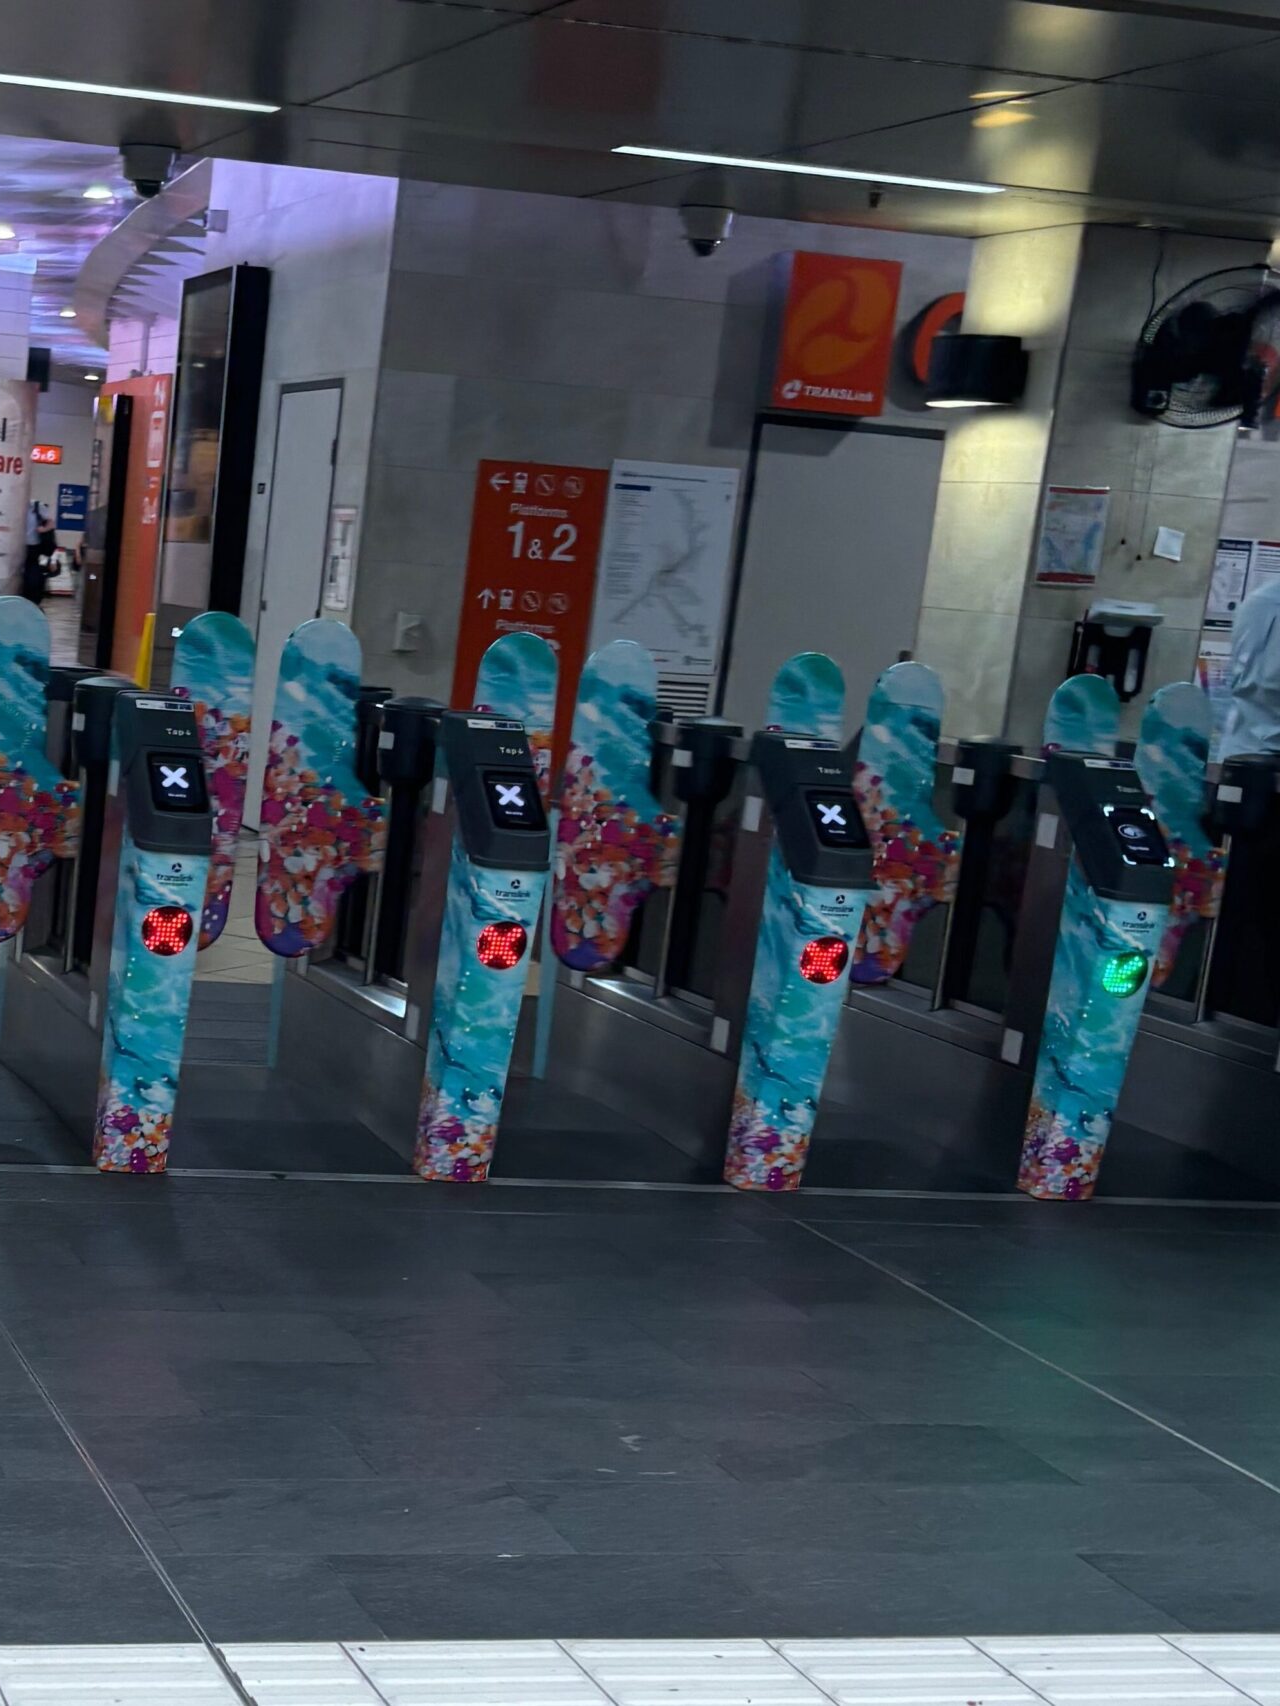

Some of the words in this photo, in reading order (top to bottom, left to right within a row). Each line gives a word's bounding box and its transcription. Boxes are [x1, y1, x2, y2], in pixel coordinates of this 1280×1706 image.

[510, 502, 569, 518] Platforms
[165, 727, 185, 736] Tap
[499, 746, 518, 756] Tap
